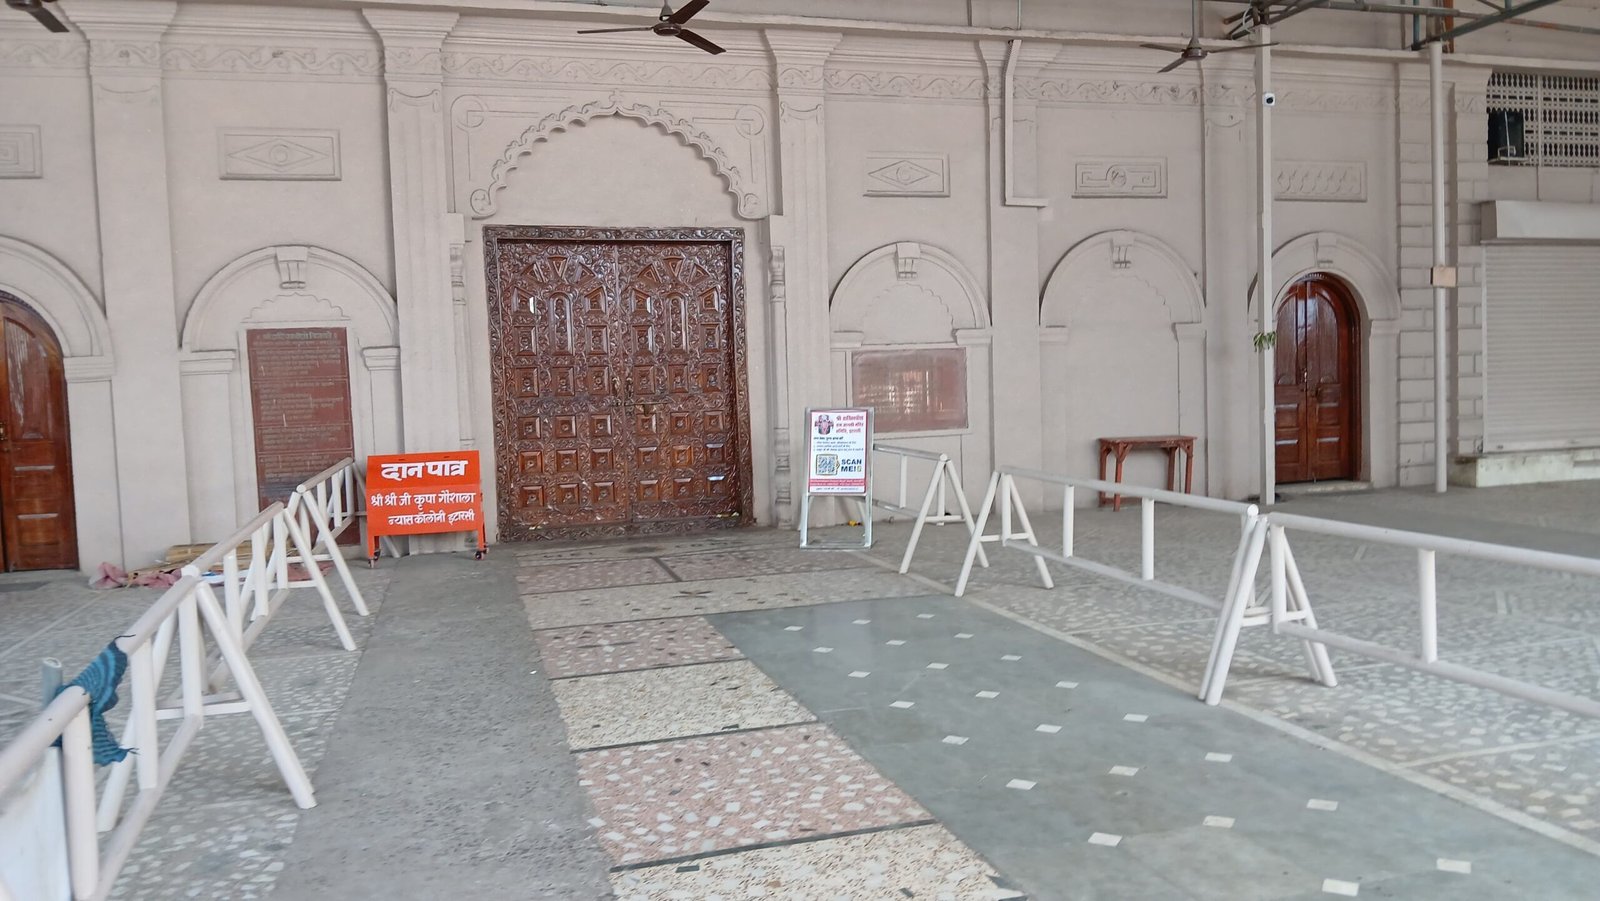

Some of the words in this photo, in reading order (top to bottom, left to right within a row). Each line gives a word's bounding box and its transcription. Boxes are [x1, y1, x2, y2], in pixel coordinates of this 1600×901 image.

[381, 462, 424, 481] दान
[426, 460, 468, 477] पात्र
[371, 492, 383, 507] श्री
[384, 492, 397, 507] श्री
[398, 492, 411, 506] जी
[414, 493, 436, 510] कृपा
[438, 490, 476, 504] गौशाला
[447, 508, 475, 525] इटारसी
